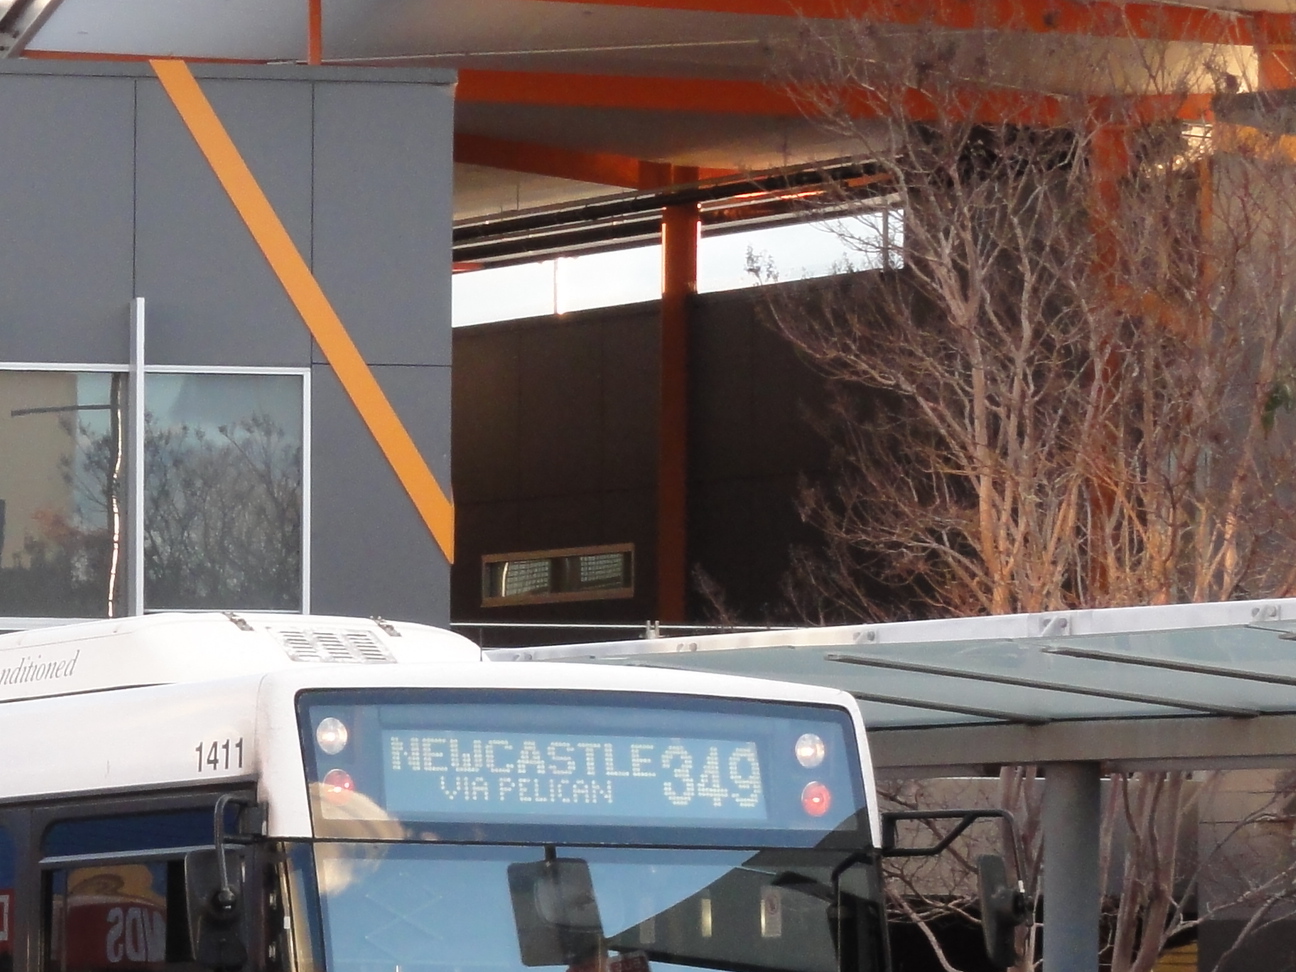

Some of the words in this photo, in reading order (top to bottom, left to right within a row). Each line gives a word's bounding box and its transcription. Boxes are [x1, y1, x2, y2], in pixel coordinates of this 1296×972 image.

[195, 737, 244, 772] 1411
[390, 736, 657, 777] NEWCASTLE
[660, 745, 764, 808] 349
[439, 776, 489, 801] VIA
[499, 777, 613, 804] PELICAN
